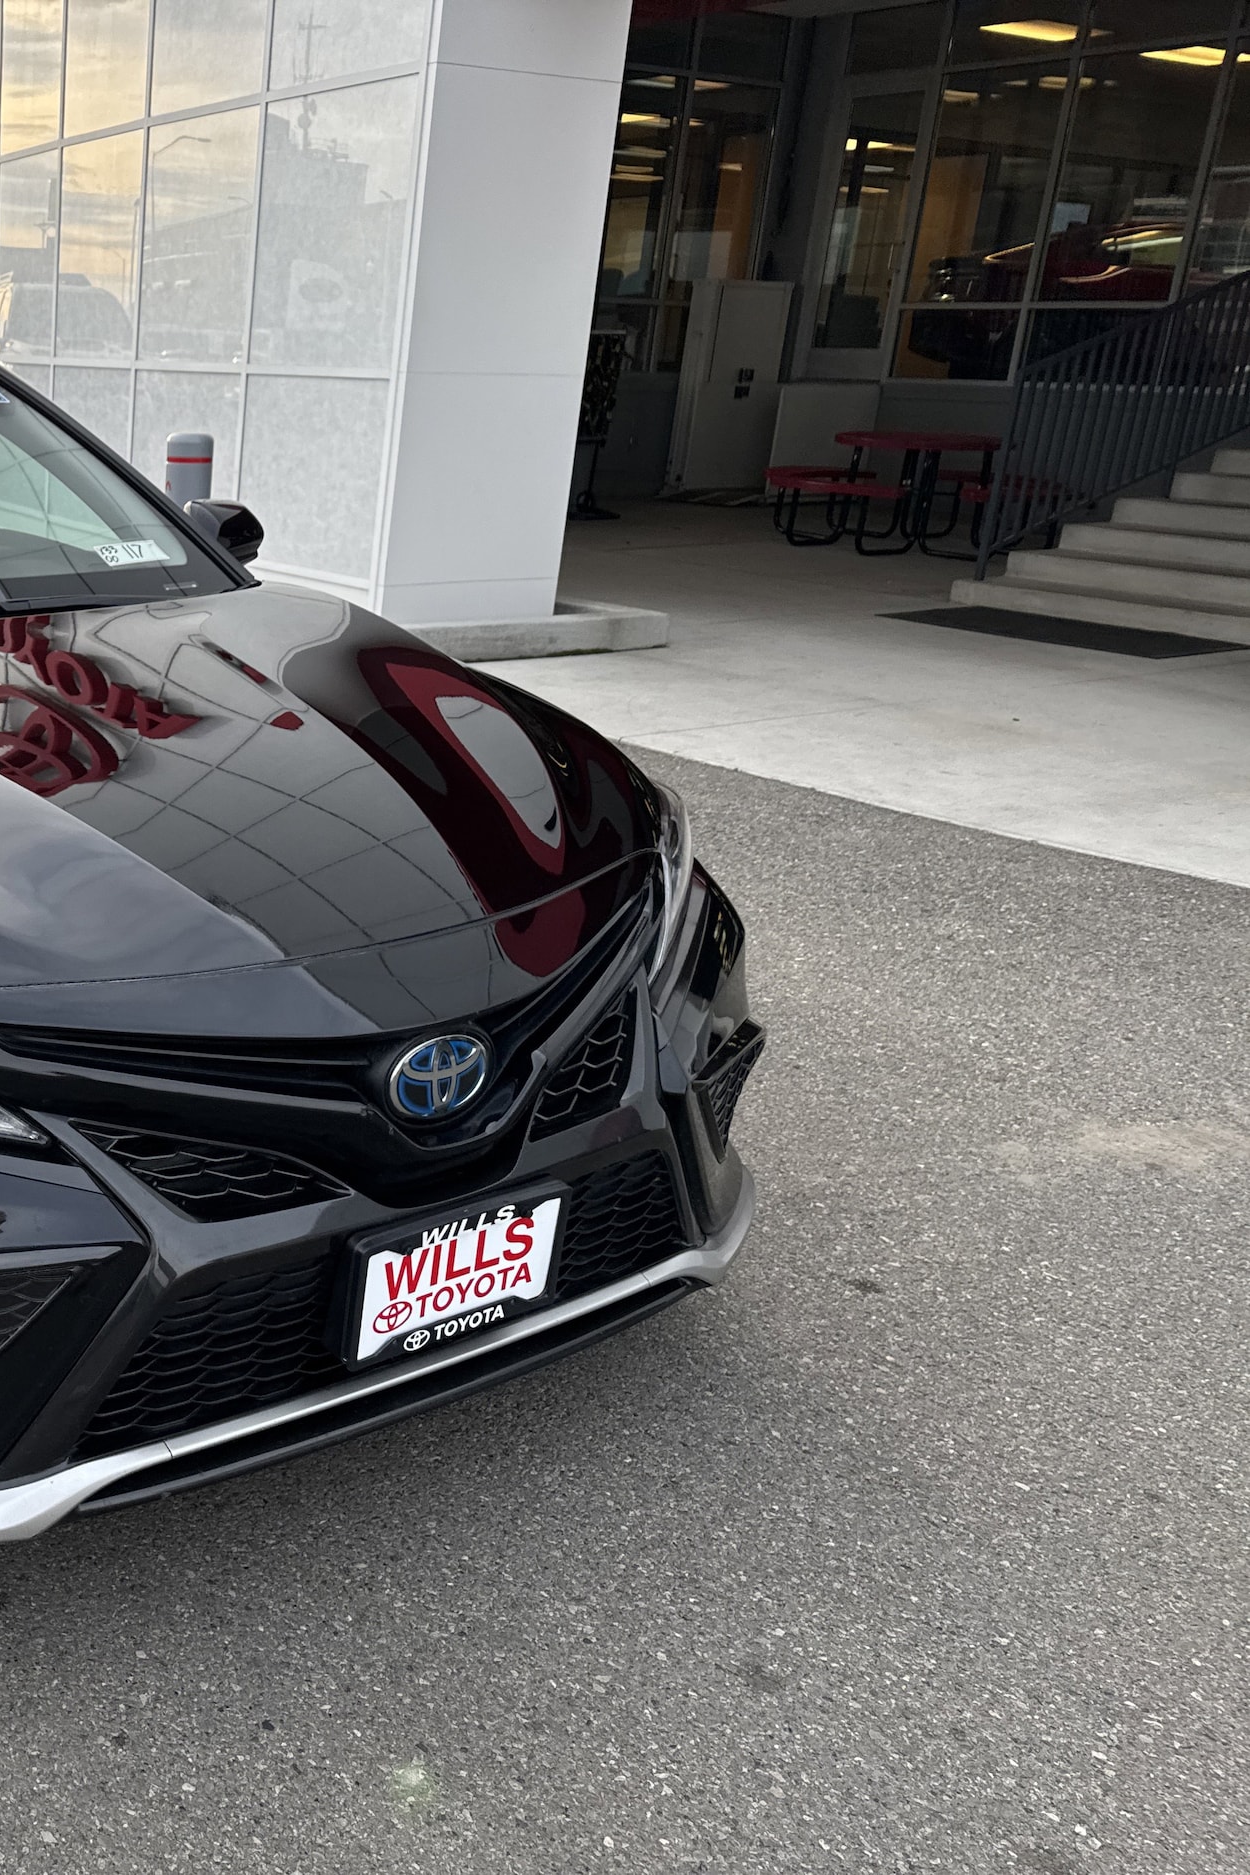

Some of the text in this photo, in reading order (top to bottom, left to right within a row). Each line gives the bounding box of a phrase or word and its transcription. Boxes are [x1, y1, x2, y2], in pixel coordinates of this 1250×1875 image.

[422, 1204, 516, 1248] WILLS
[385, 1217, 535, 1301] WILLS
[416, 1262, 532, 1318] TOYOTA
[433, 1304, 505, 1341] TOYOTA
